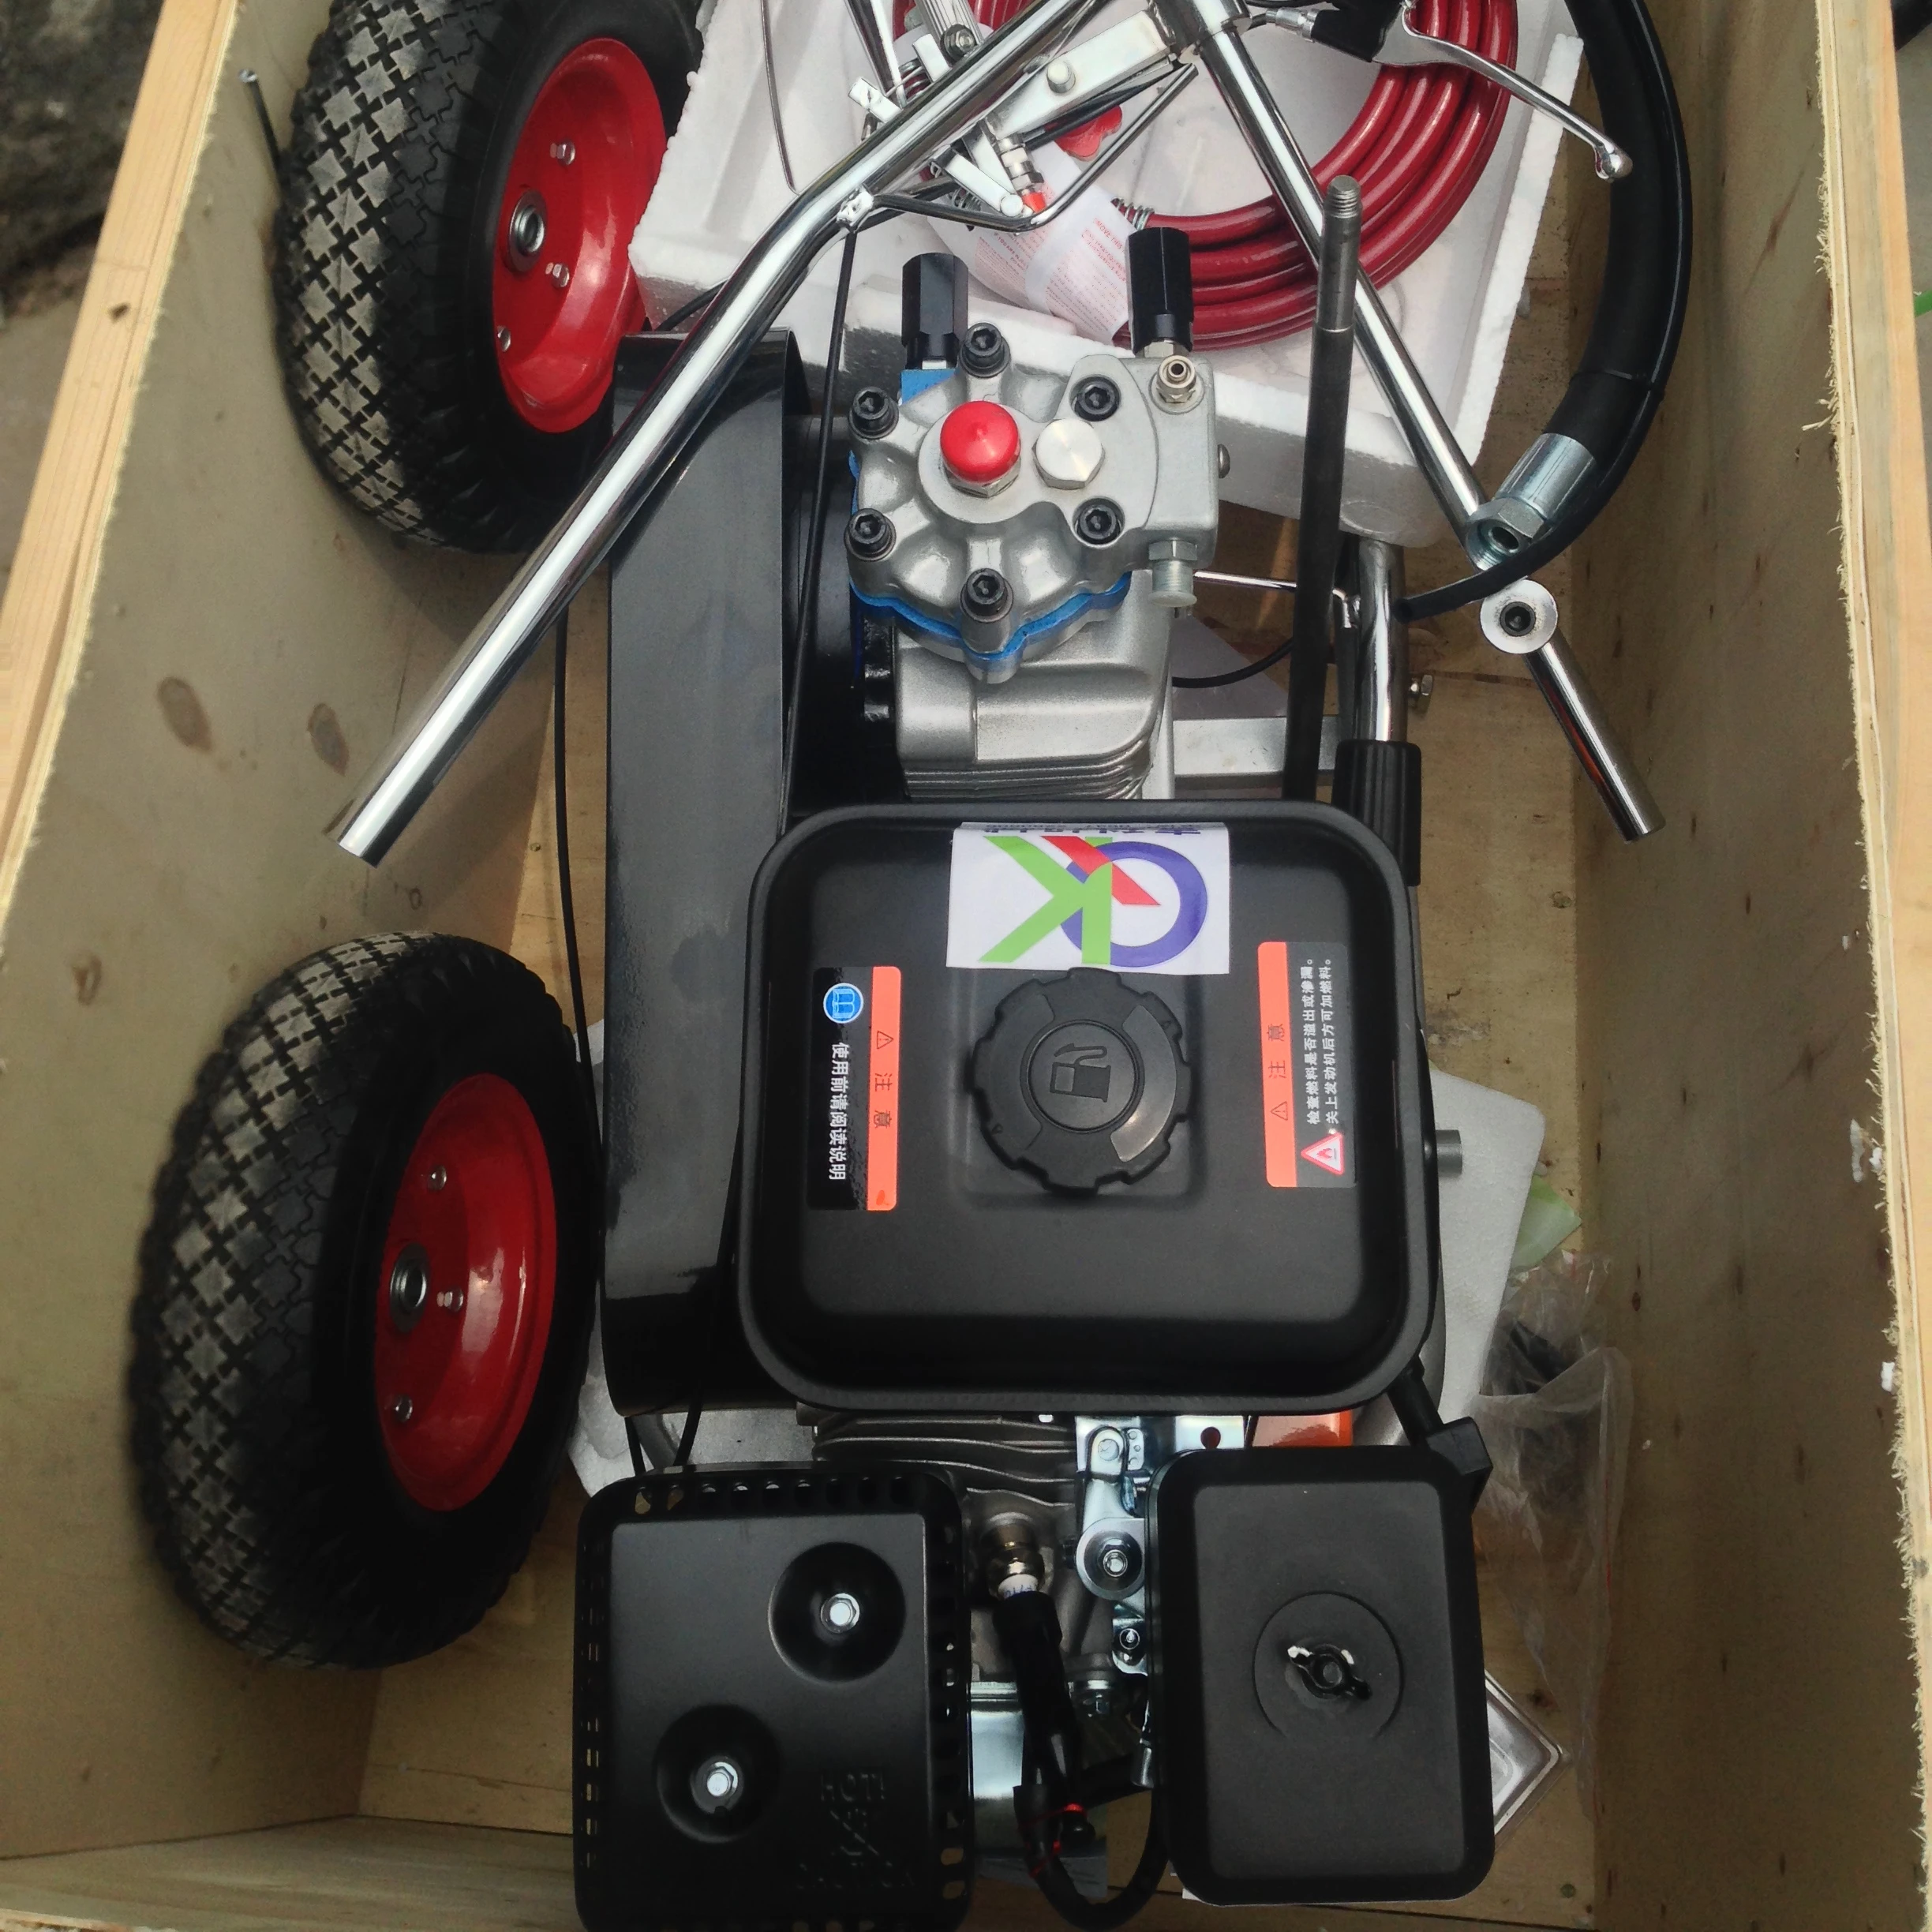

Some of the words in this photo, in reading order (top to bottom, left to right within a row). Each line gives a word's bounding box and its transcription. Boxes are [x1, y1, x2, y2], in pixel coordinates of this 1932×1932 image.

[1266, 1023, 1286, 1080] 注意
[828, 1042, 850, 1181] 使用前请阅读说明
[873, 1072, 893, 1130] 注意
